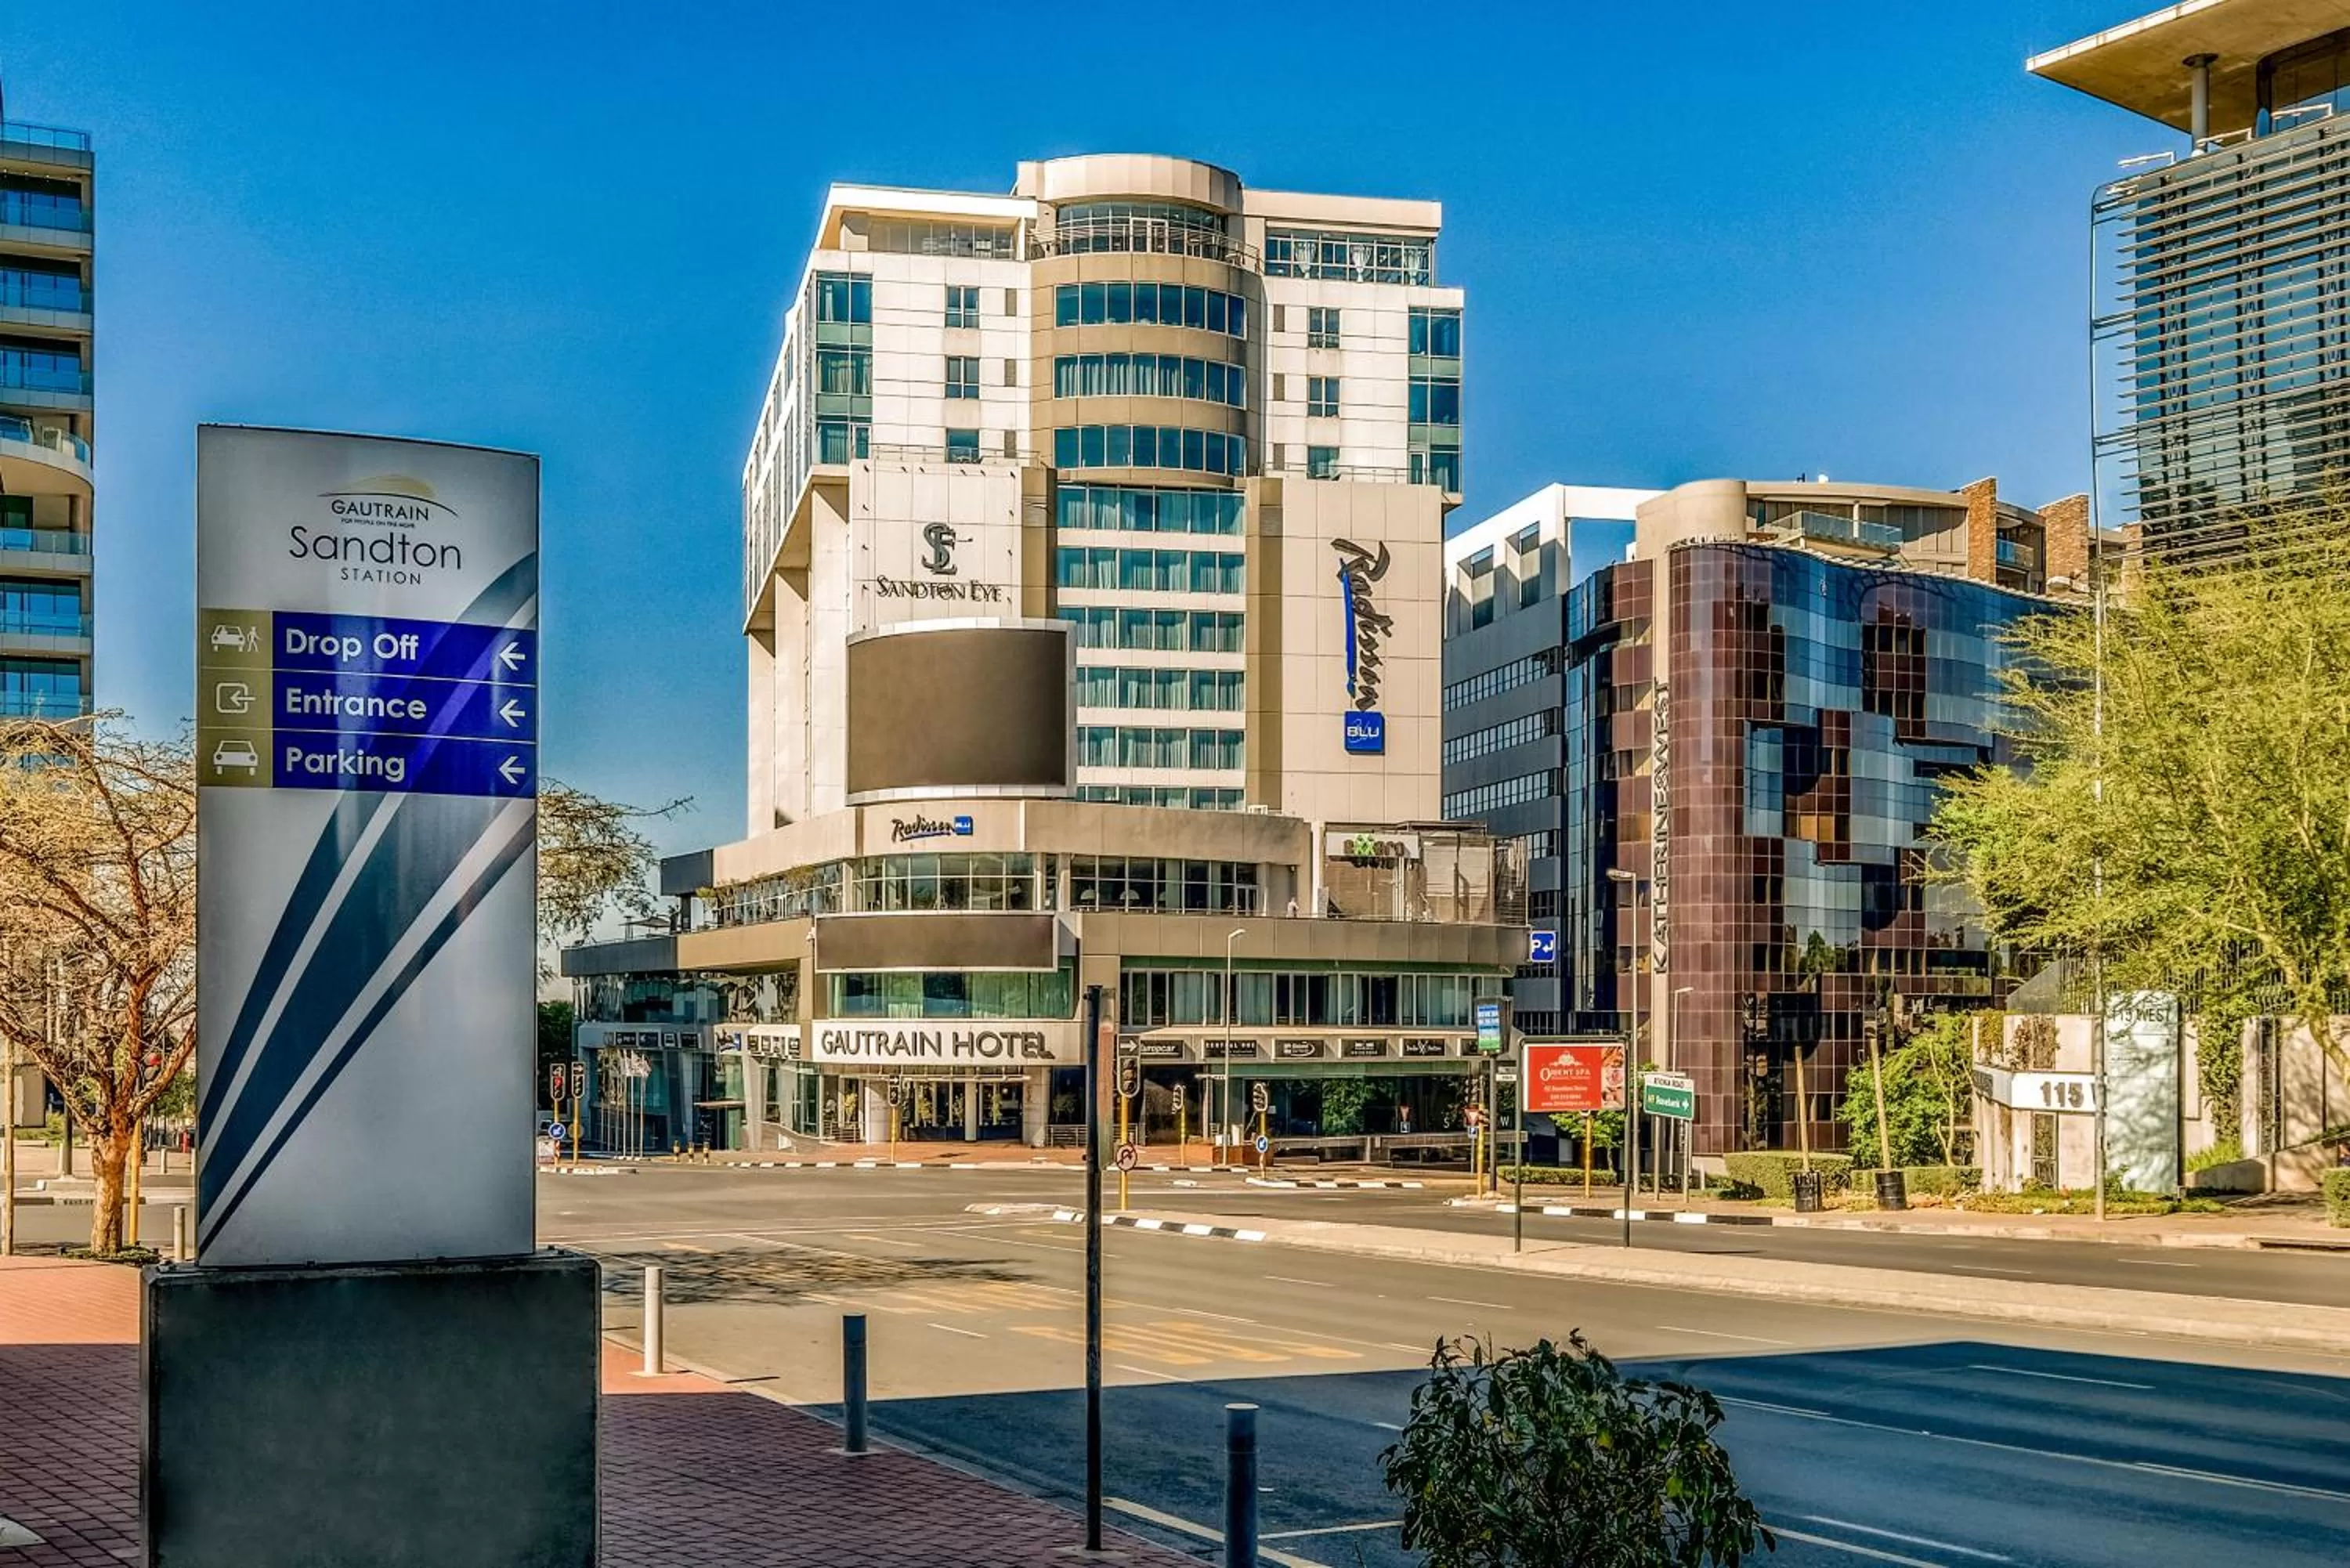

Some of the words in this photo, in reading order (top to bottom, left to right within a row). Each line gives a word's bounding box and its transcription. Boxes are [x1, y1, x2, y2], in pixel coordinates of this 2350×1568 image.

[331, 500, 428, 520] GAUTRAIN
[289, 526, 461, 569] Sandton
[341, 568, 422, 585] STATION
[1330, 537, 1394, 711] Radisson
[285, 628, 362, 662] Drop
[373, 633, 419, 660] Off
[285, 687, 427, 720] Entrance
[1347, 725, 1380, 737] BLU
[1654, 676, 1669, 772] WEST
[285, 746, 406, 782] Parking
[891, 815, 956, 843] Radisson
[1654, 790, 1668, 974] KATHERINE
[2136, 1007, 2171, 1022] WEST
[821, 1029, 942, 1057] GAUTRAIN
[952, 1030, 1056, 1059] HOTEL
[2039, 1081, 2084, 1108] 115
